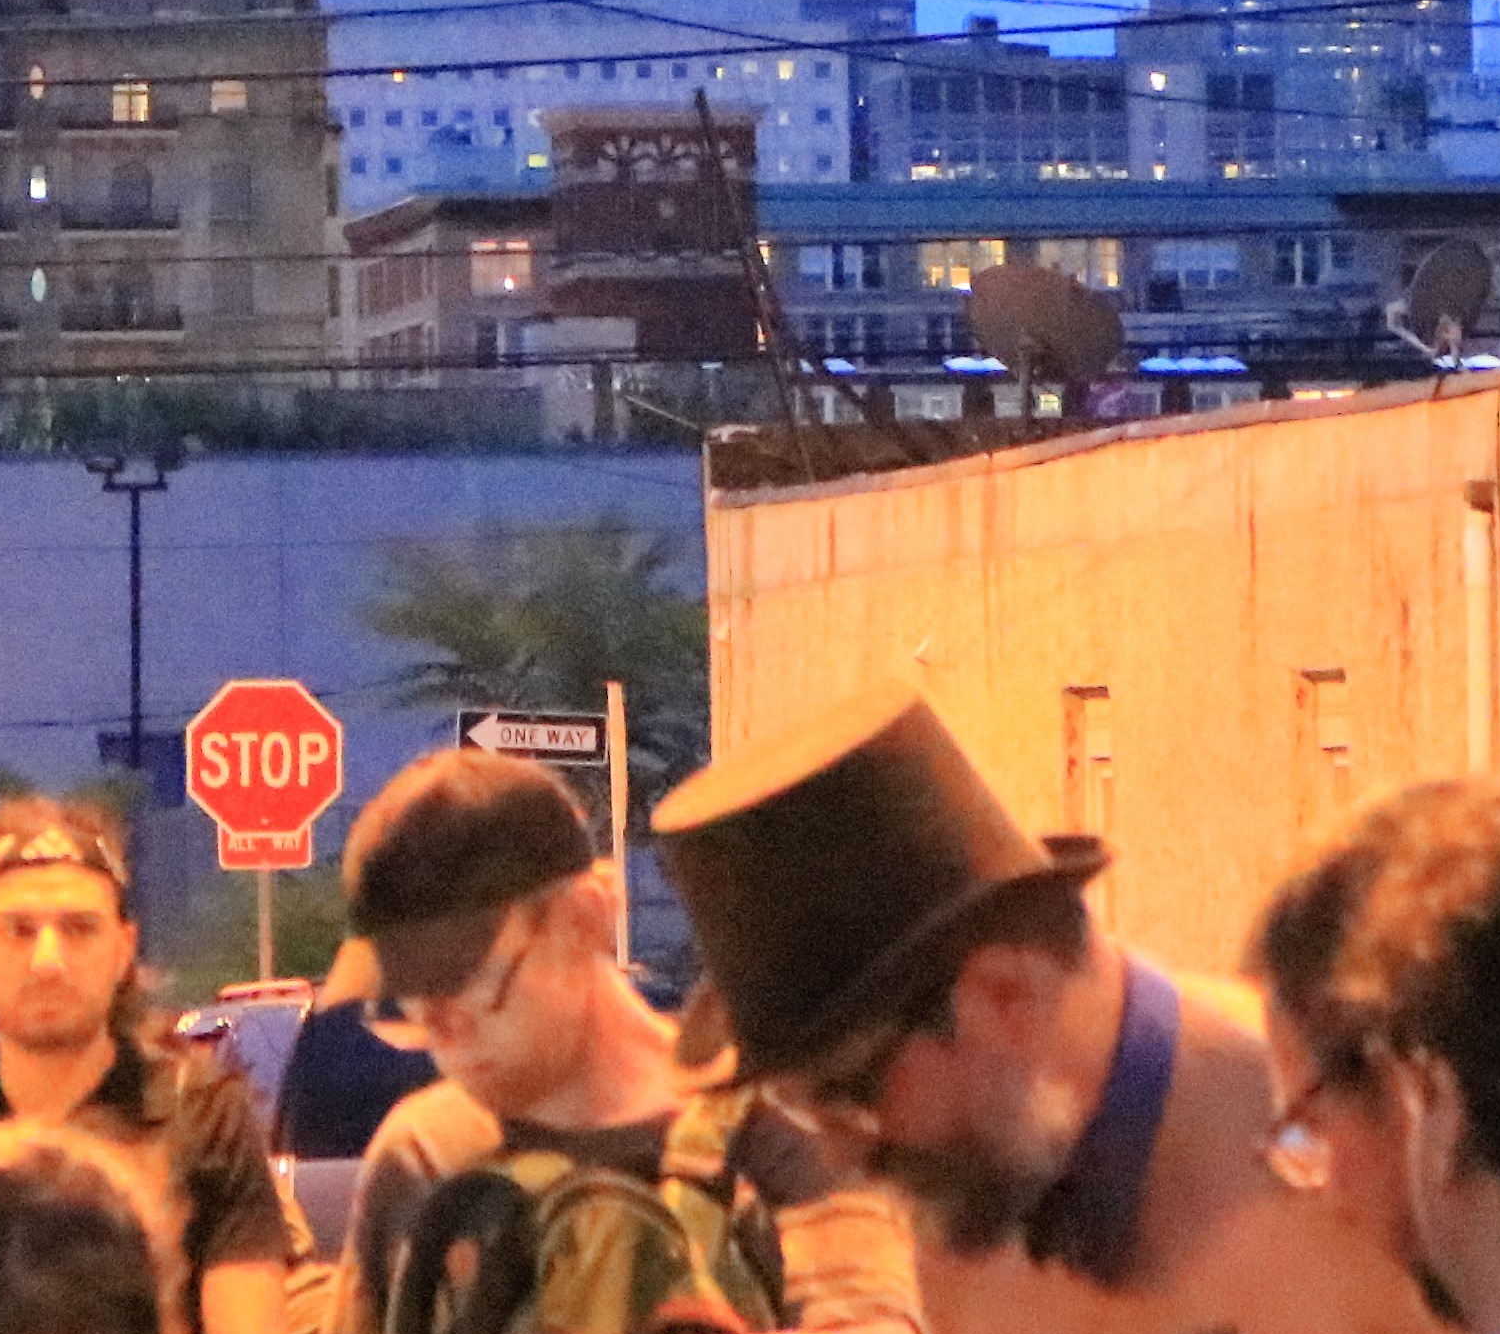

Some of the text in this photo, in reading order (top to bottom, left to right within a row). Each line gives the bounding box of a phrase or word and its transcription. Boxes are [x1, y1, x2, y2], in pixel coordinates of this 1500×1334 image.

[500, 727, 589, 748] ONE WAY
[199, 731, 330, 789] STOP
[227, 834, 301, 852] ALL WAY
